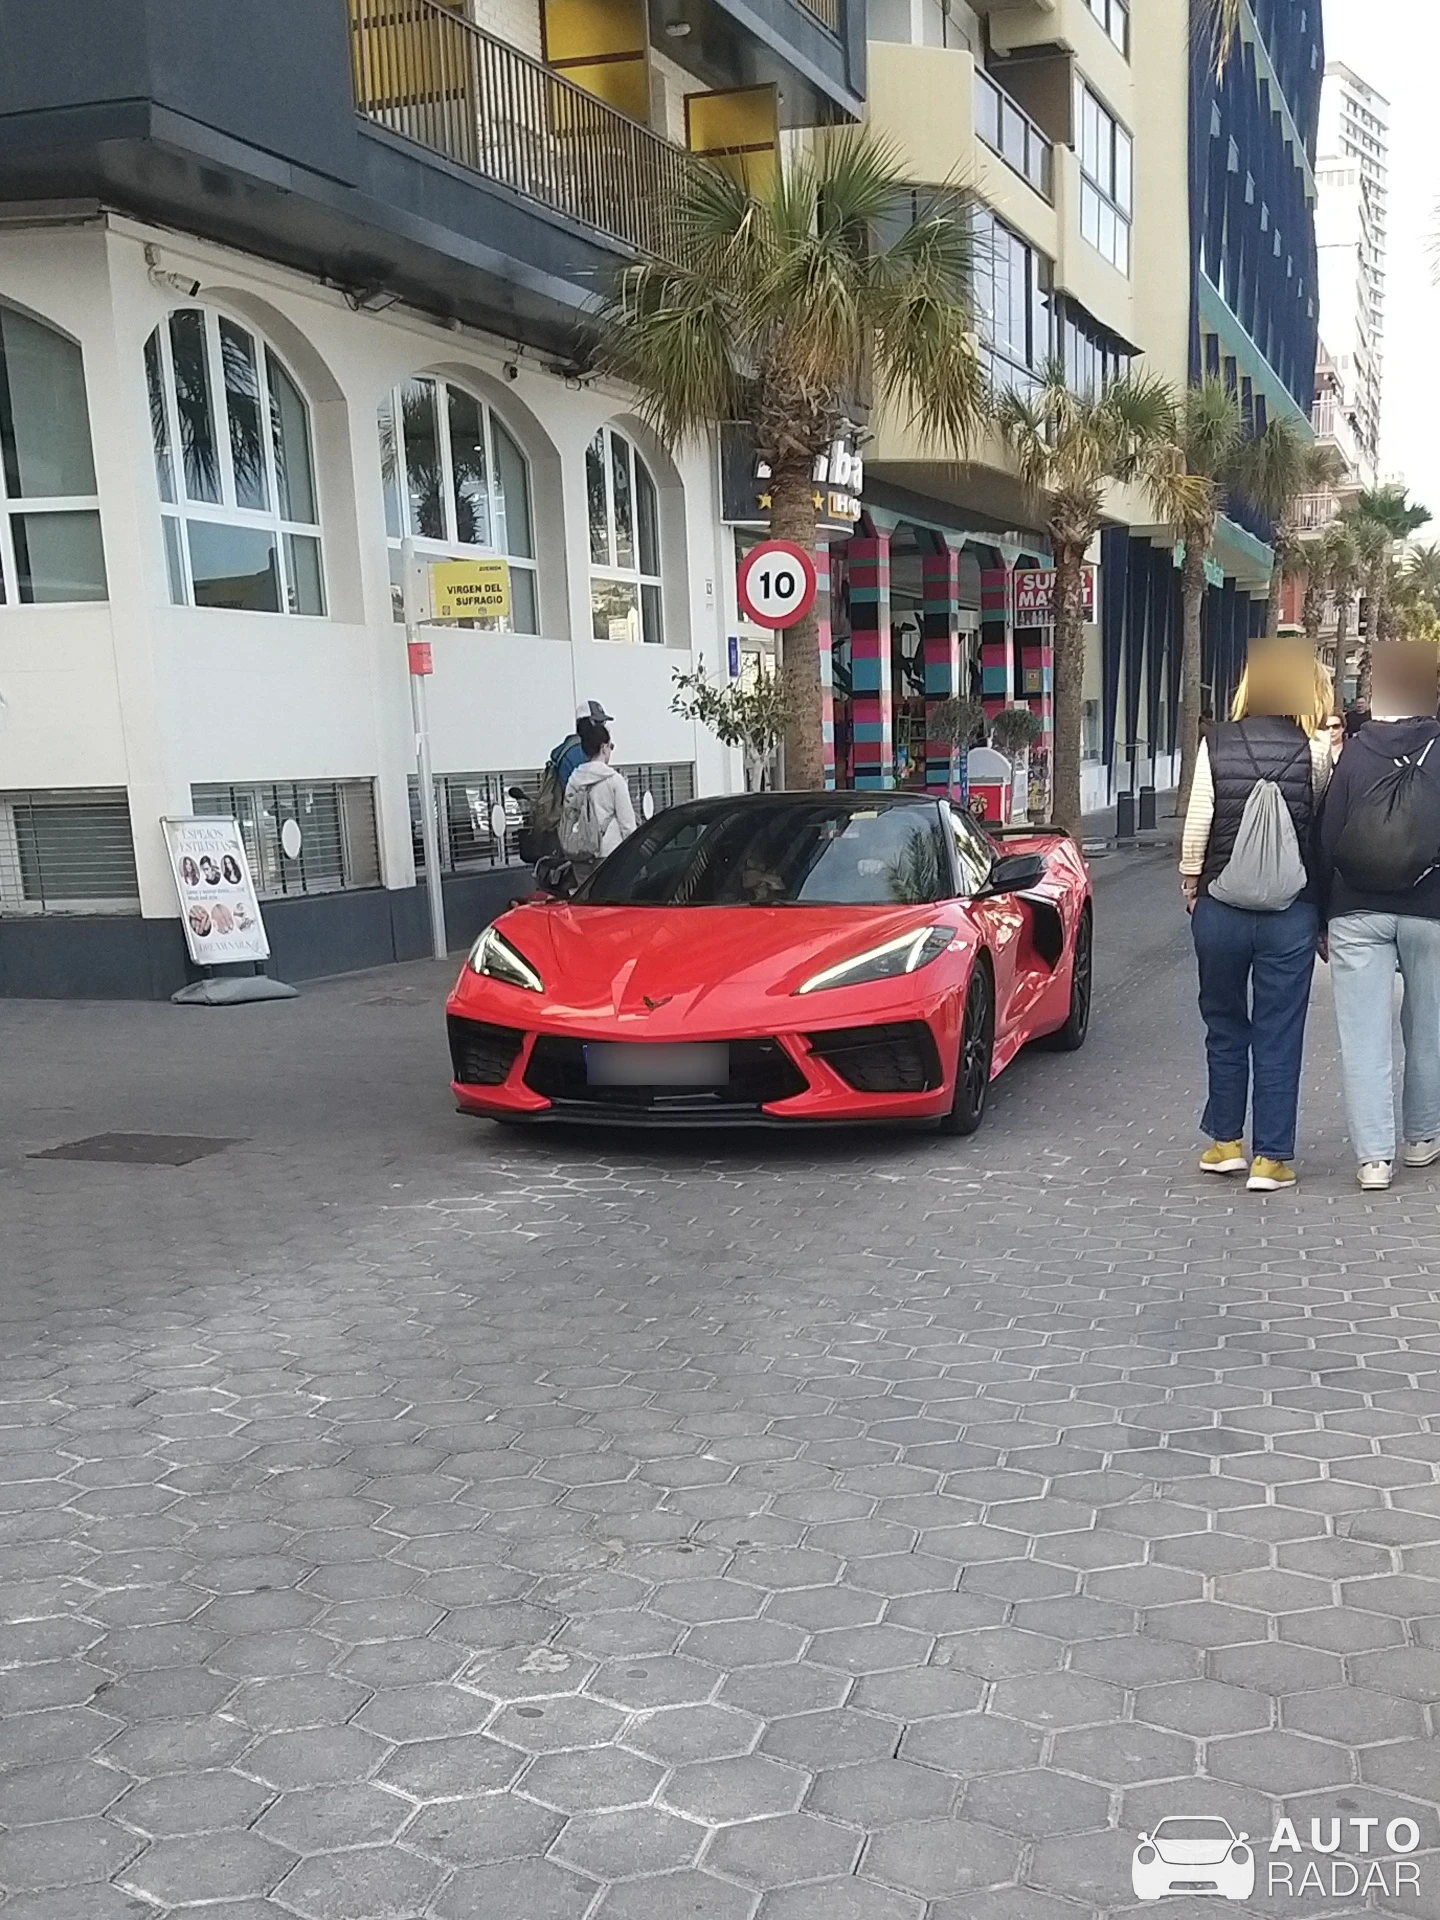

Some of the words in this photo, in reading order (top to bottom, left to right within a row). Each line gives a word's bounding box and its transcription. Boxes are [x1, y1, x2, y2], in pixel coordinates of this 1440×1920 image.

[446, 585, 482, 595] VIRGEN
[484, 583, 503, 593] DEL
[759, 571, 795, 599] 10
[455, 595, 503, 606] SUFRAGIO
